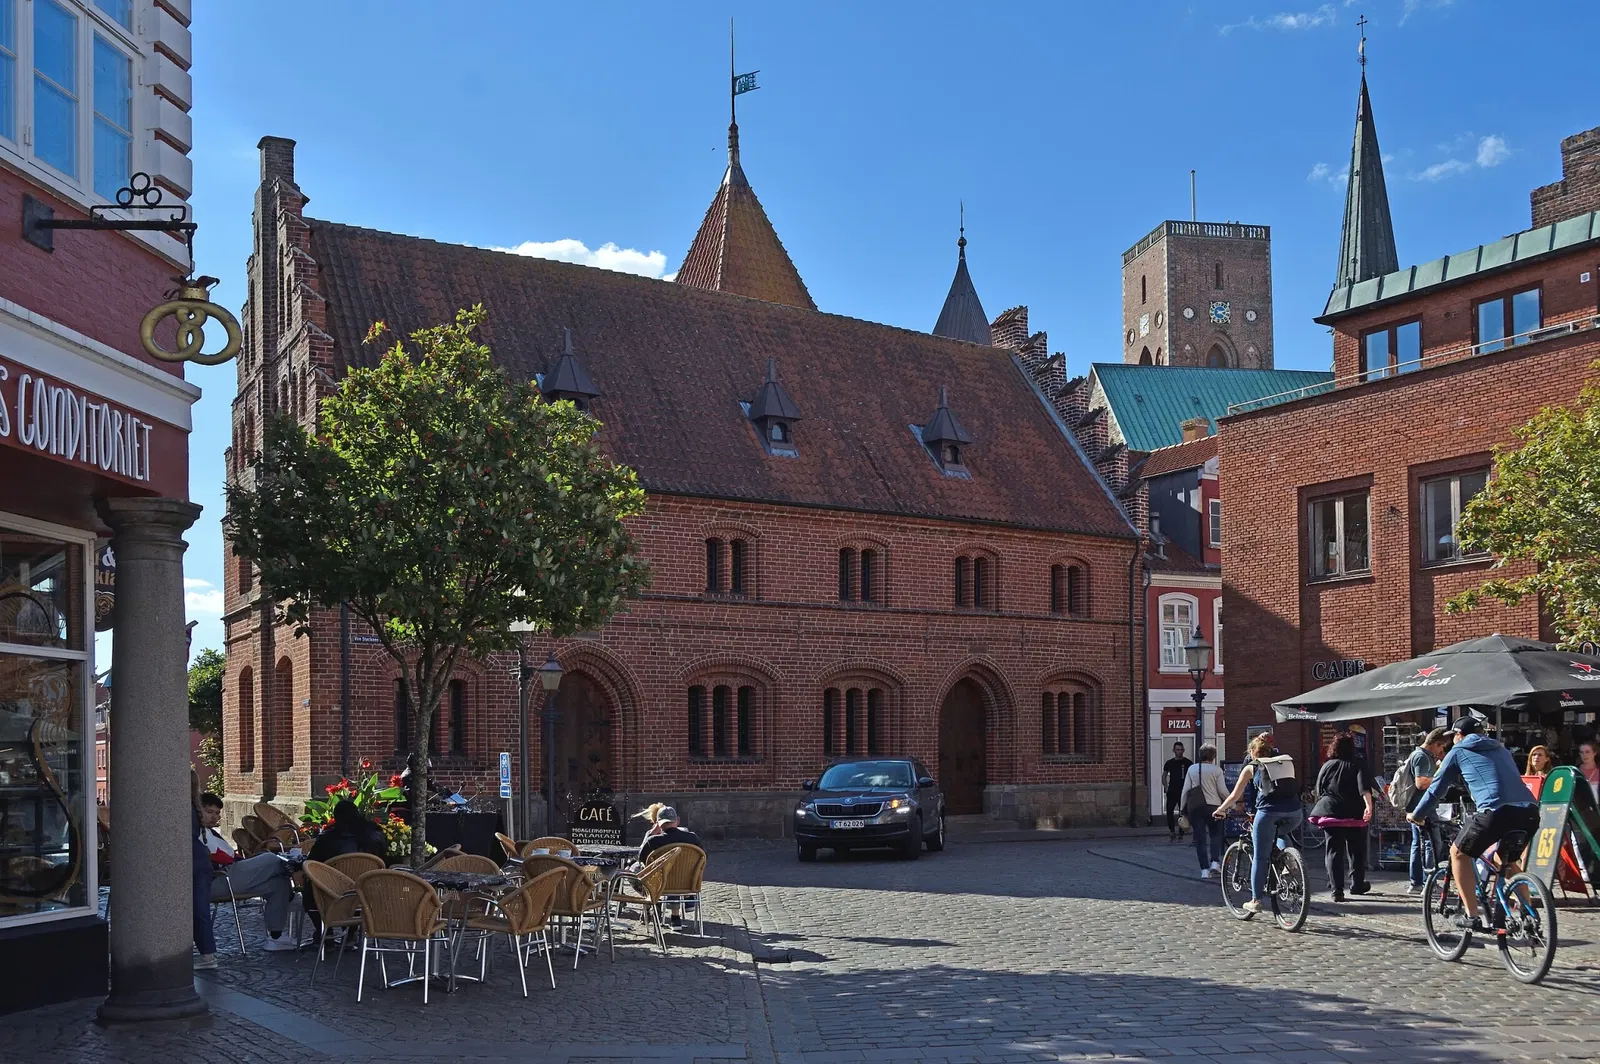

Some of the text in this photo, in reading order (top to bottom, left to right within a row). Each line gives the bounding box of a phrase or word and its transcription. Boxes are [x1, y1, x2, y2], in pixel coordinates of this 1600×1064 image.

[18, 374, 152, 482] CONDITORIET
[1371, 676, 1453, 691] Heineken
[1559, 700, 1585, 708] Heineken
[1168, 720, 1191, 729] PIZZA
[580, 806, 613, 822] CAFÉ
[1537, 828, 1557, 858] 63
